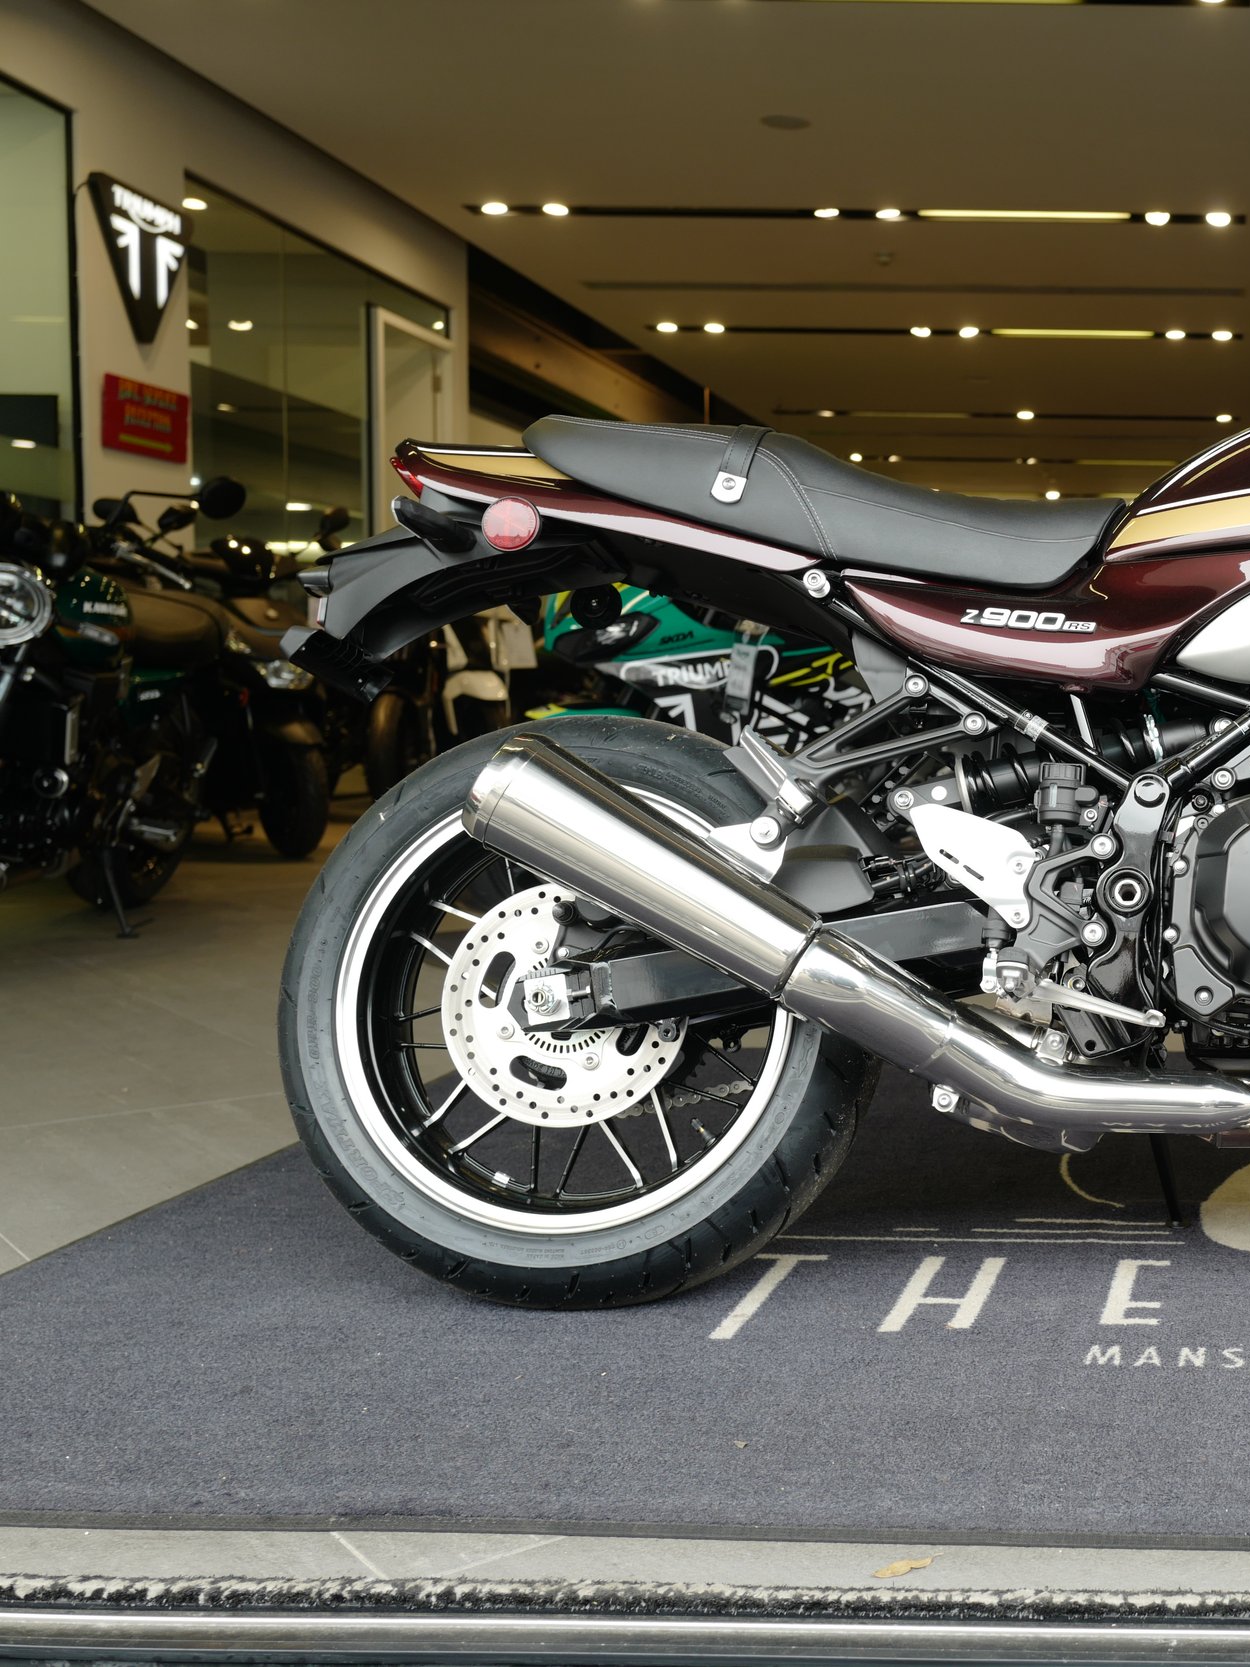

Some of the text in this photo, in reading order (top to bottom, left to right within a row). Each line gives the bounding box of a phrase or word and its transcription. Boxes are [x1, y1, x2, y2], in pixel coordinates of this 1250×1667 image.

[111, 184, 181, 235] TRIUMPH
[652, 660, 734, 688] TRIUMP
[708, 1254, 1171, 1340] THE
